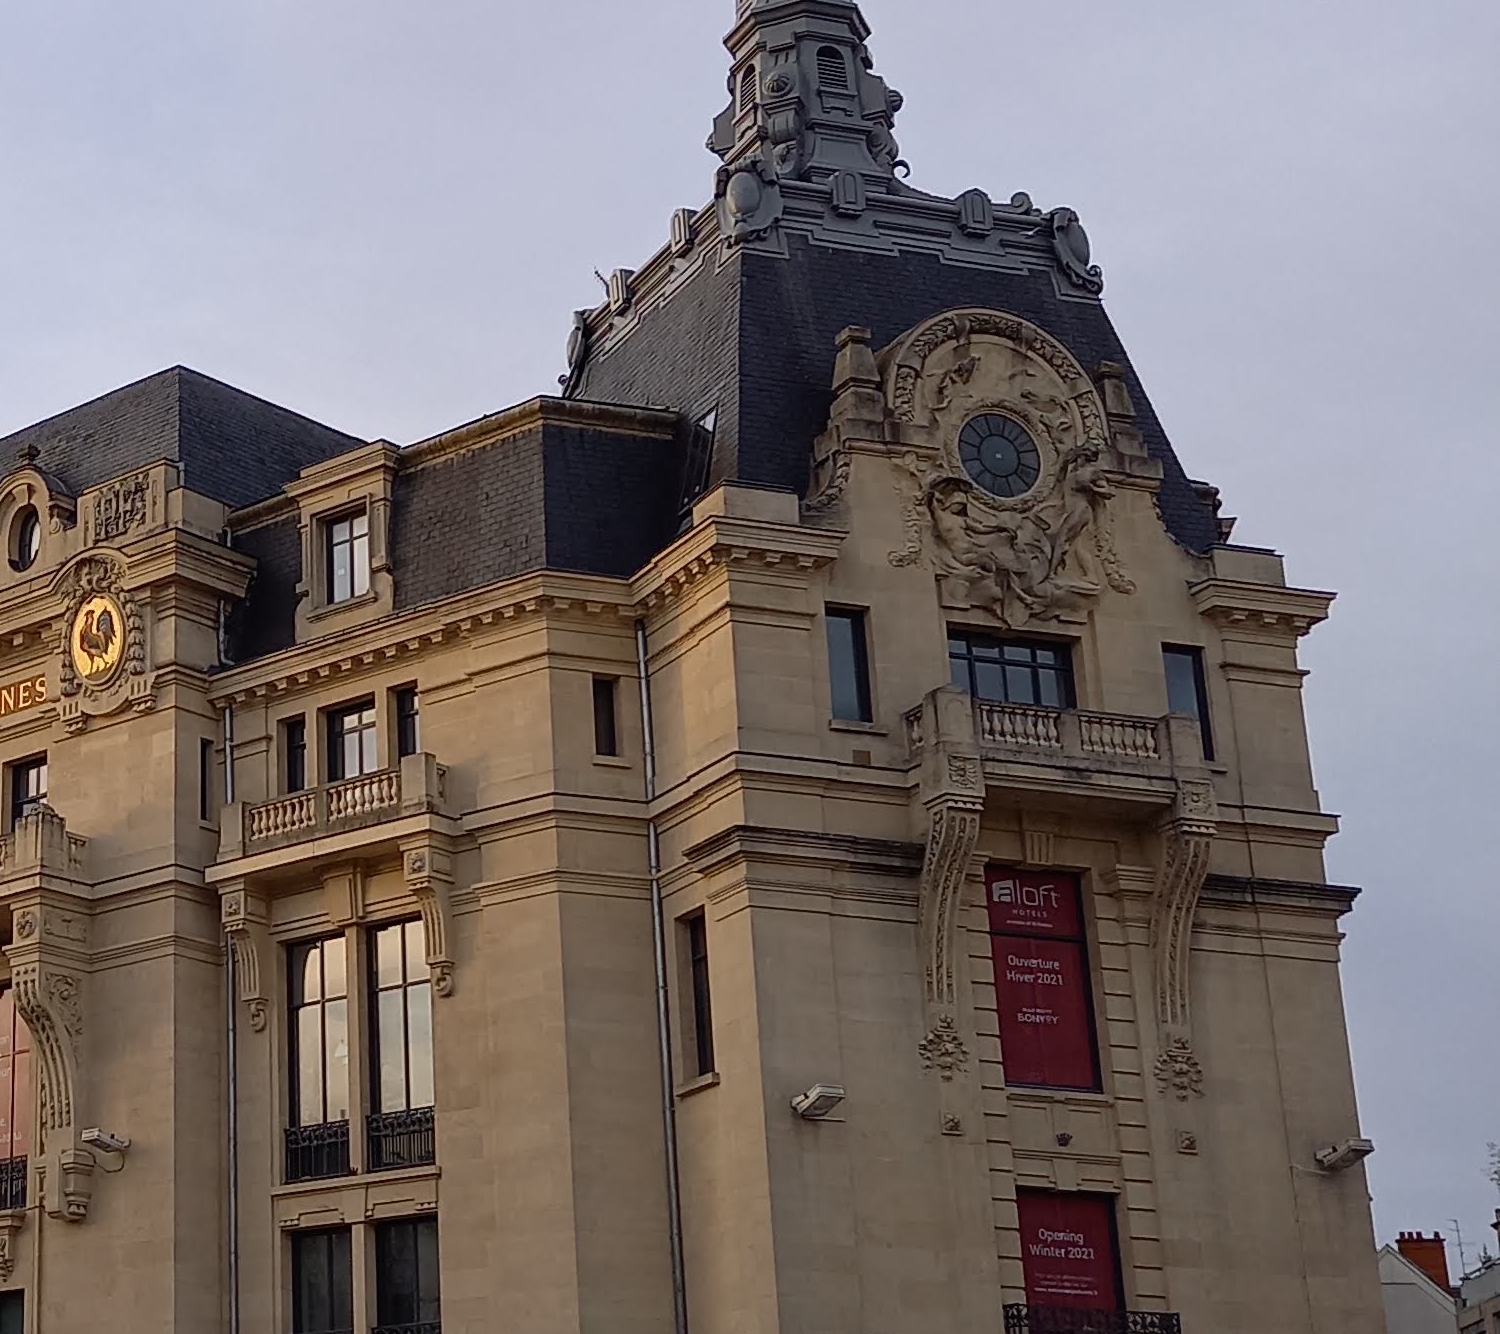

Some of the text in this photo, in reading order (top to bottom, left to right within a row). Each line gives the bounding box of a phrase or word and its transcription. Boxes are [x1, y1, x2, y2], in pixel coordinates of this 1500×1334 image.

[992, 879, 1059, 908] aloft
[1008, 955, 1060, 970] Ouverture
[1006, 970, 1063, 985] Hiver 2021
[1038, 1228, 1084, 1245] Opening
[1029, 1244, 1095, 1259] Winter 2021
